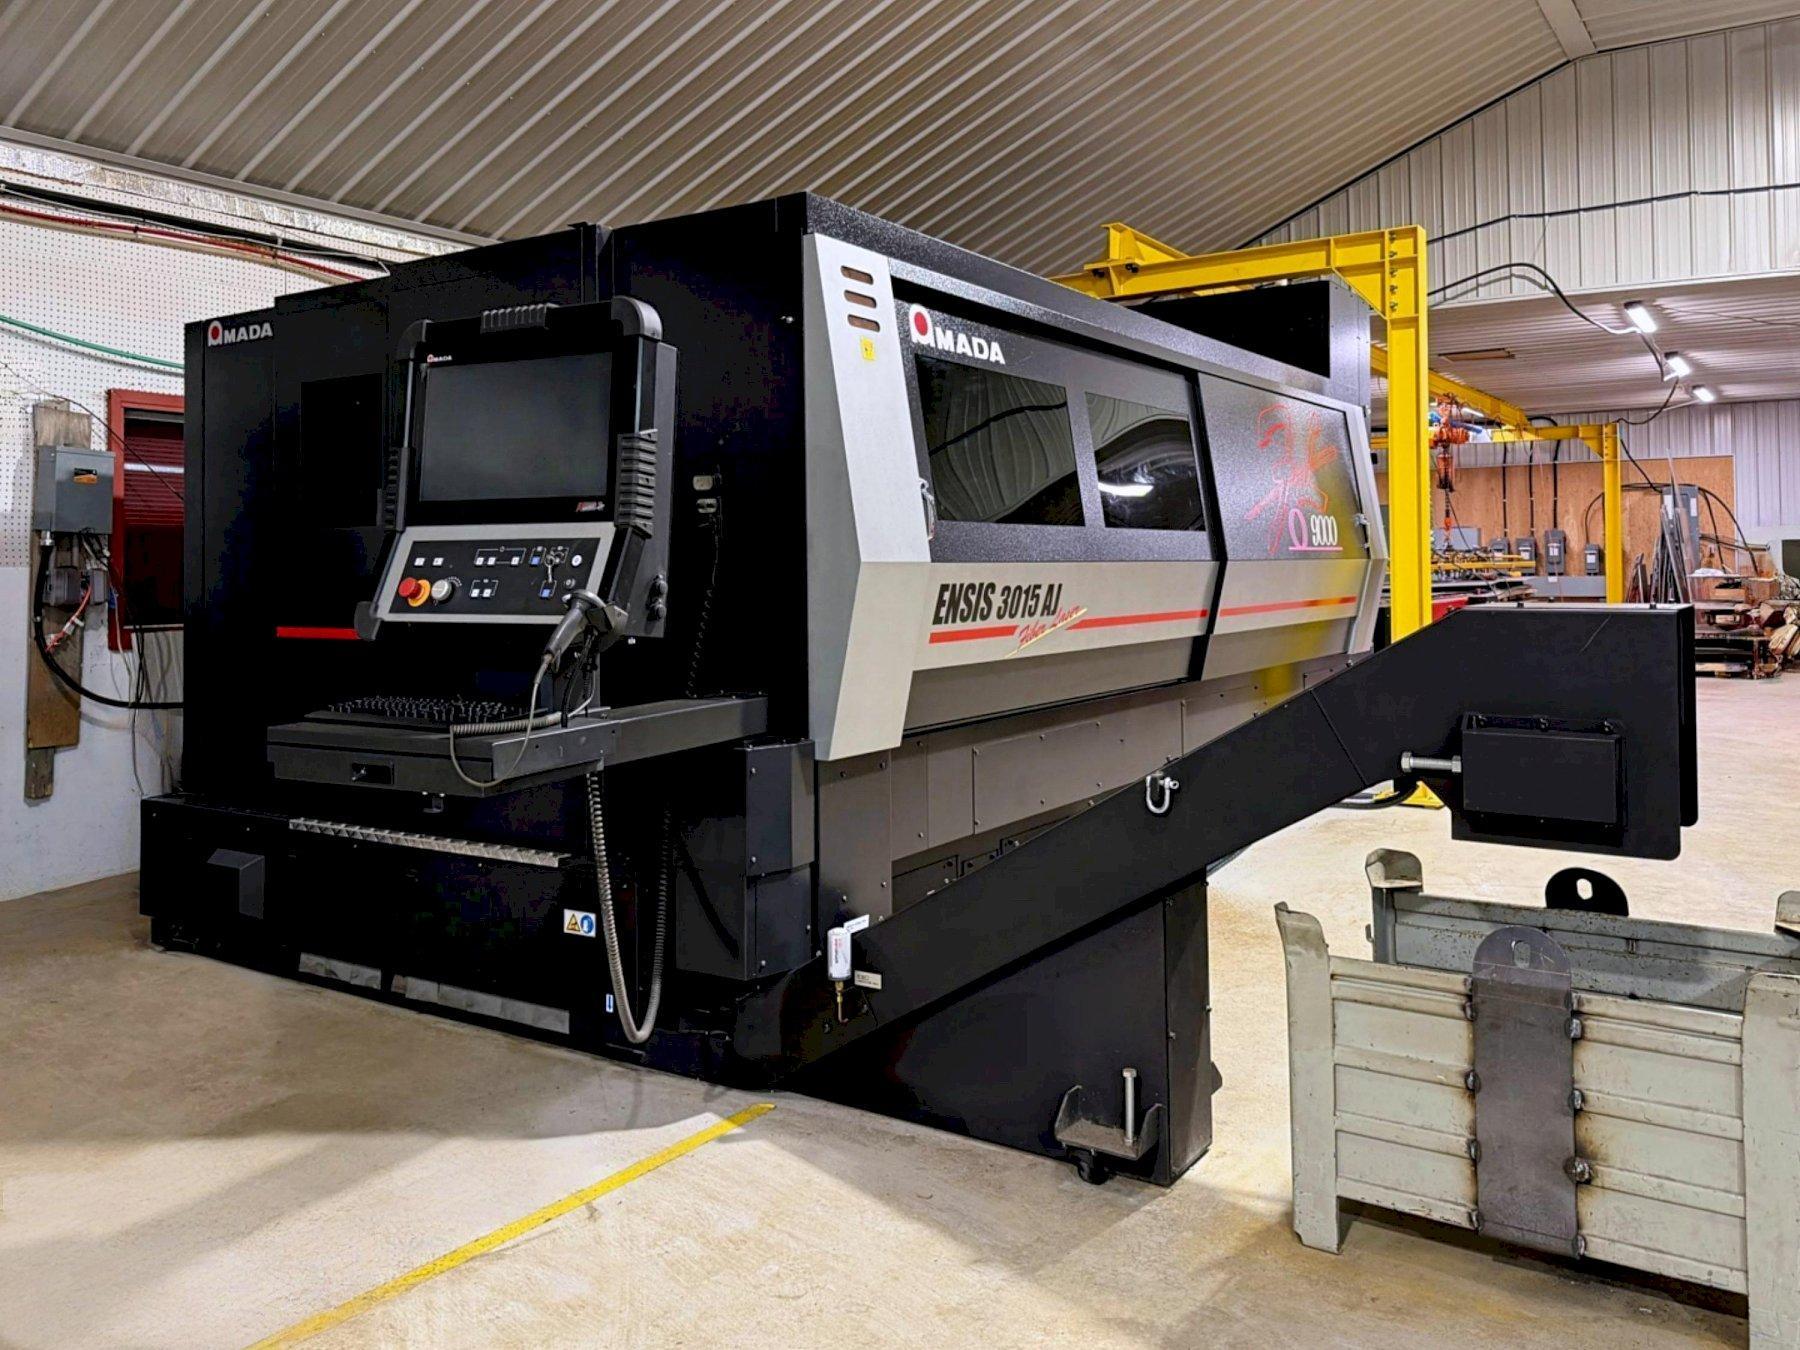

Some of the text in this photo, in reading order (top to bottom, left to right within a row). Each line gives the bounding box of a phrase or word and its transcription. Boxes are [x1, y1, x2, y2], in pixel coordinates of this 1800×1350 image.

[1311, 514, 1338, 546] 9000
[932, 581, 1063, 625] ENSIS 3015 AJ
